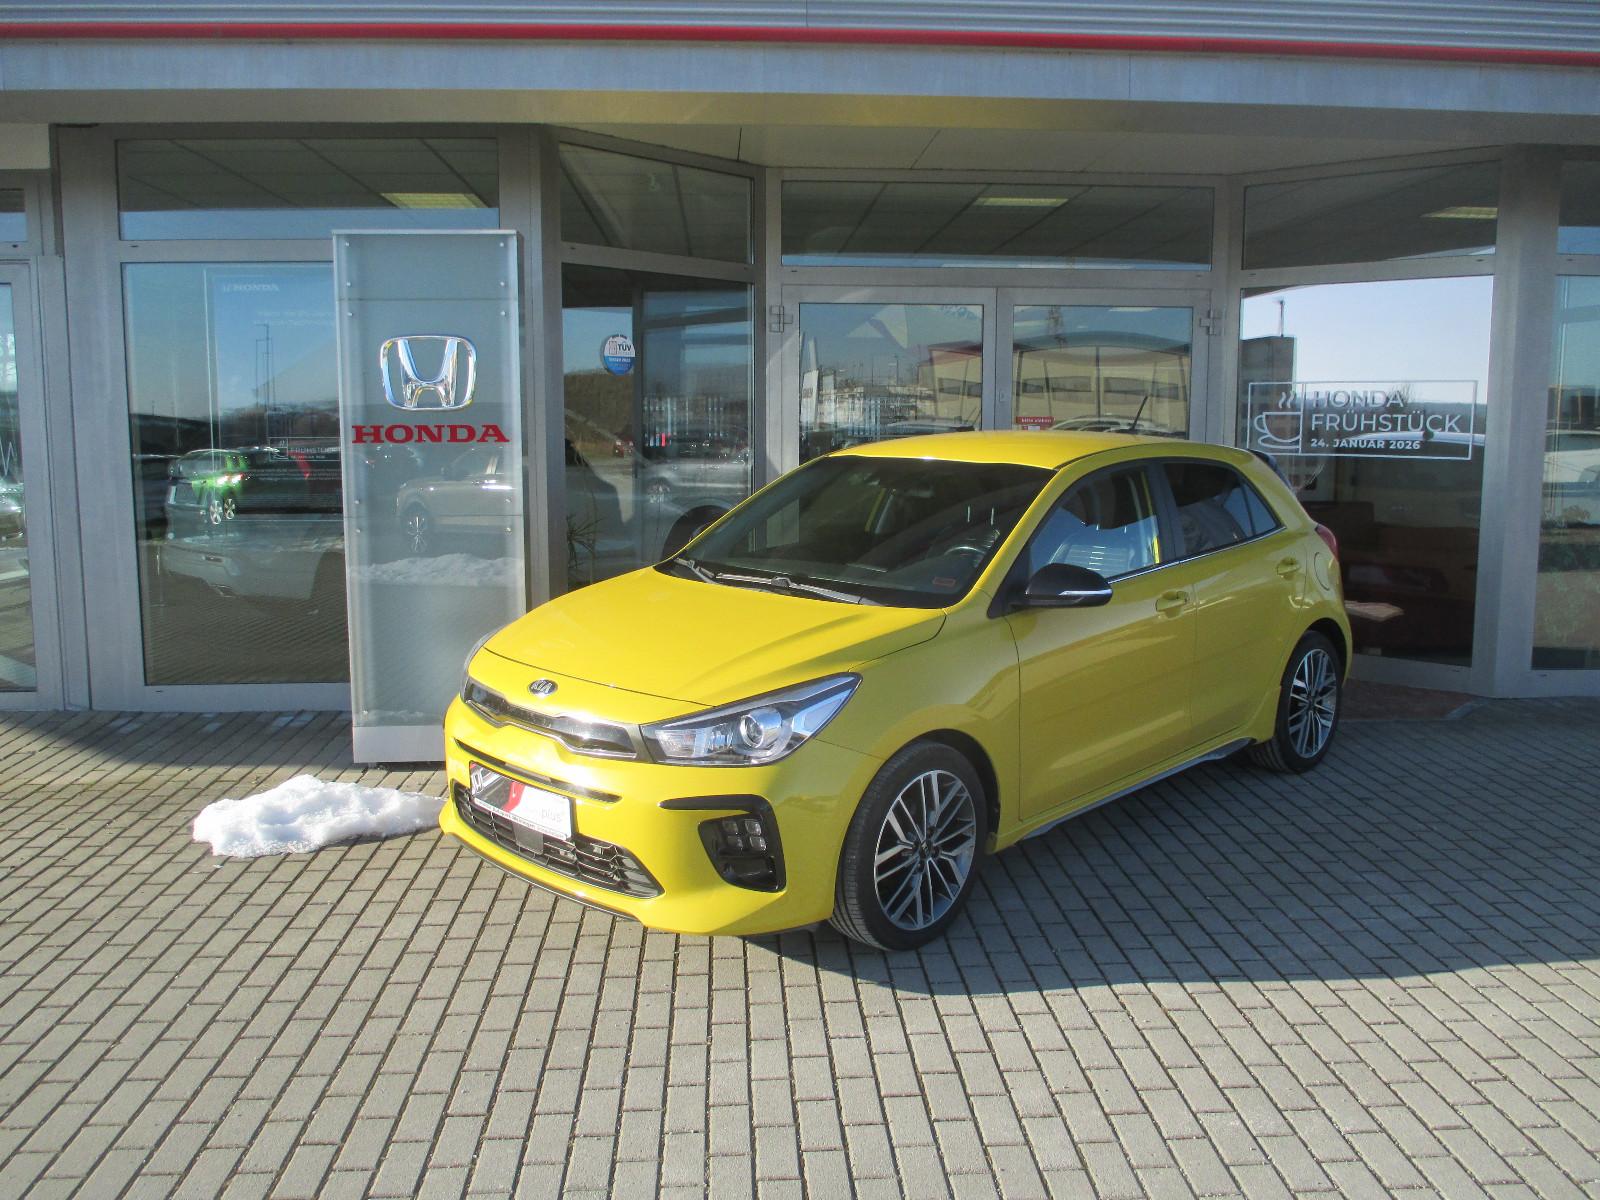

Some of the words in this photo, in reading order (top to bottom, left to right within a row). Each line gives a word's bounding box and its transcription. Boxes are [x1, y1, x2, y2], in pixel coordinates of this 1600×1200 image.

[618, 341, 631, 351] TÜV
[1312, 390, 1403, 408] HONDA
[1311, 410, 1462, 433] FRÜHSTÜCK
[352, 424, 509, 443] HONDA
[1310, 438, 1329, 448] 24.
[1333, 438, 1386, 450] JANUAR
[1389, 440, 1421, 450] 2026
